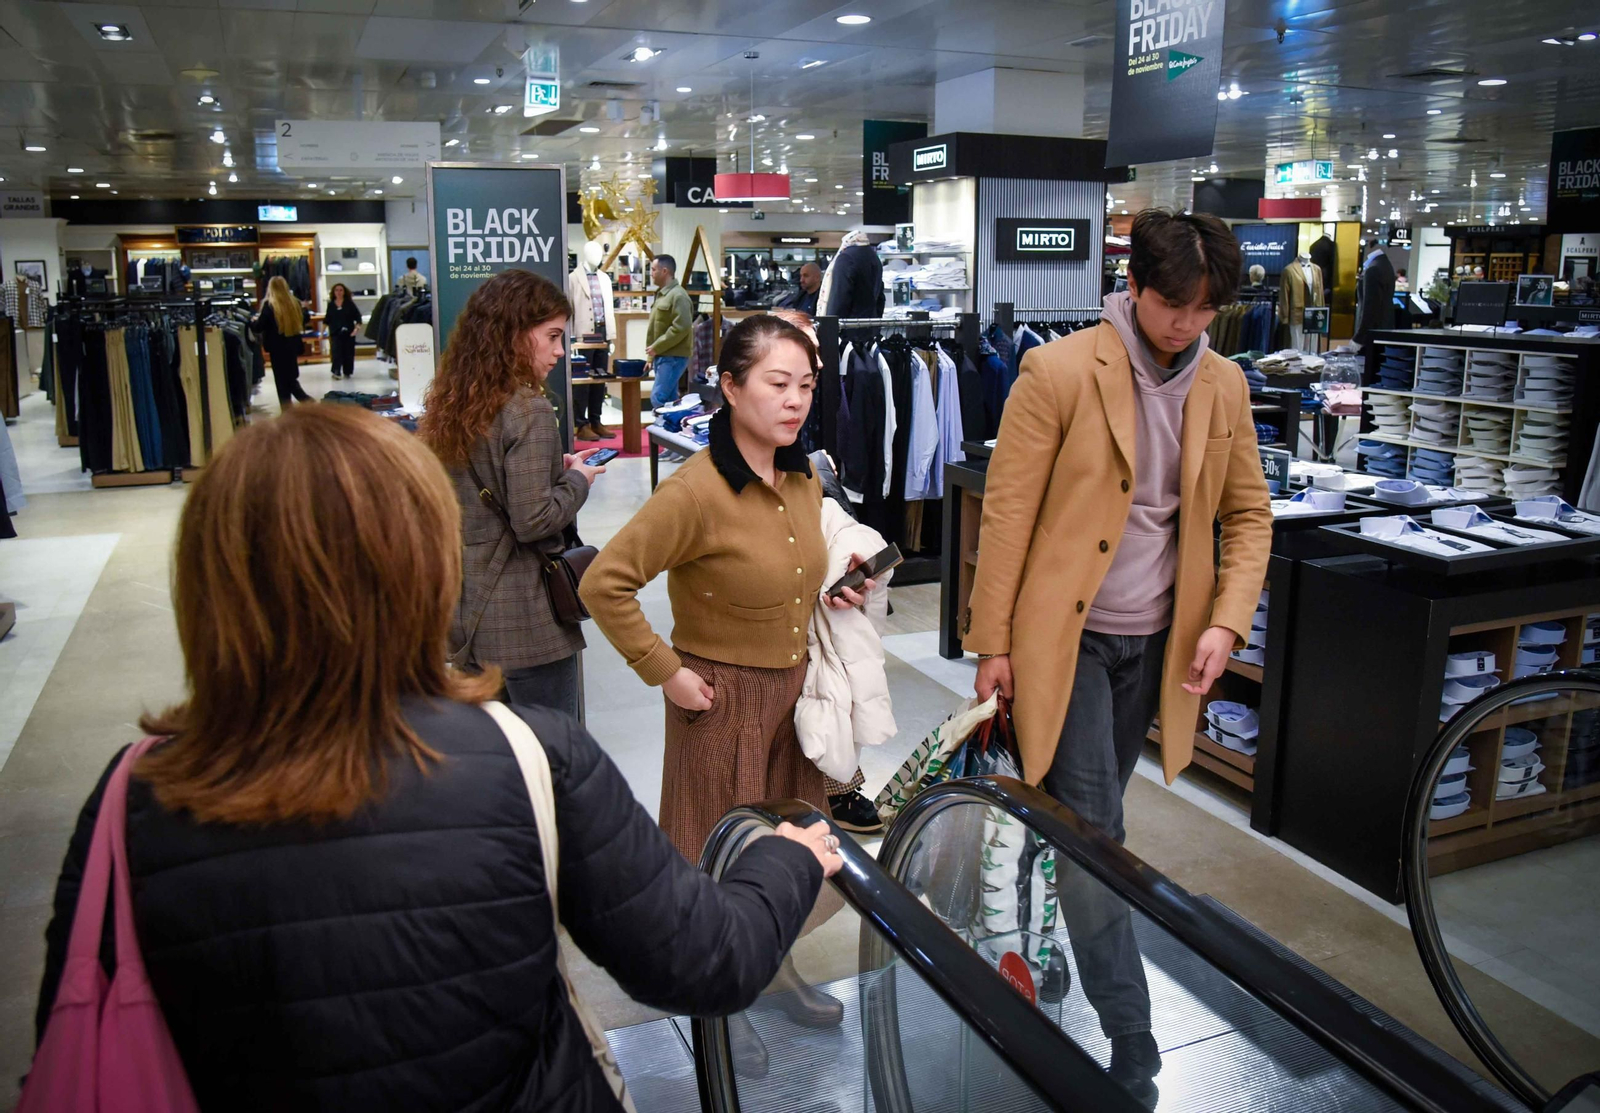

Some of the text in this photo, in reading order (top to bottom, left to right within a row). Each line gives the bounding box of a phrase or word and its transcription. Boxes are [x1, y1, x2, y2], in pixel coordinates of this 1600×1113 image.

[1128, 1, 1213, 56] FRIDAY
[1128, 52, 1160, 66] Del 24 al 30
[1136, 62, 1164, 74] noviembre
[281, 122, 292, 137] 2
[916, 150, 944, 166] MIRTO
[1557, 174, 1600, 190] FRIDA
[447, 208, 540, 235] BLACK
[203, 228, 234, 238] POLO
[1022, 233, 1070, 246] MIRTO
[448, 236, 555, 263] FRIDAY
